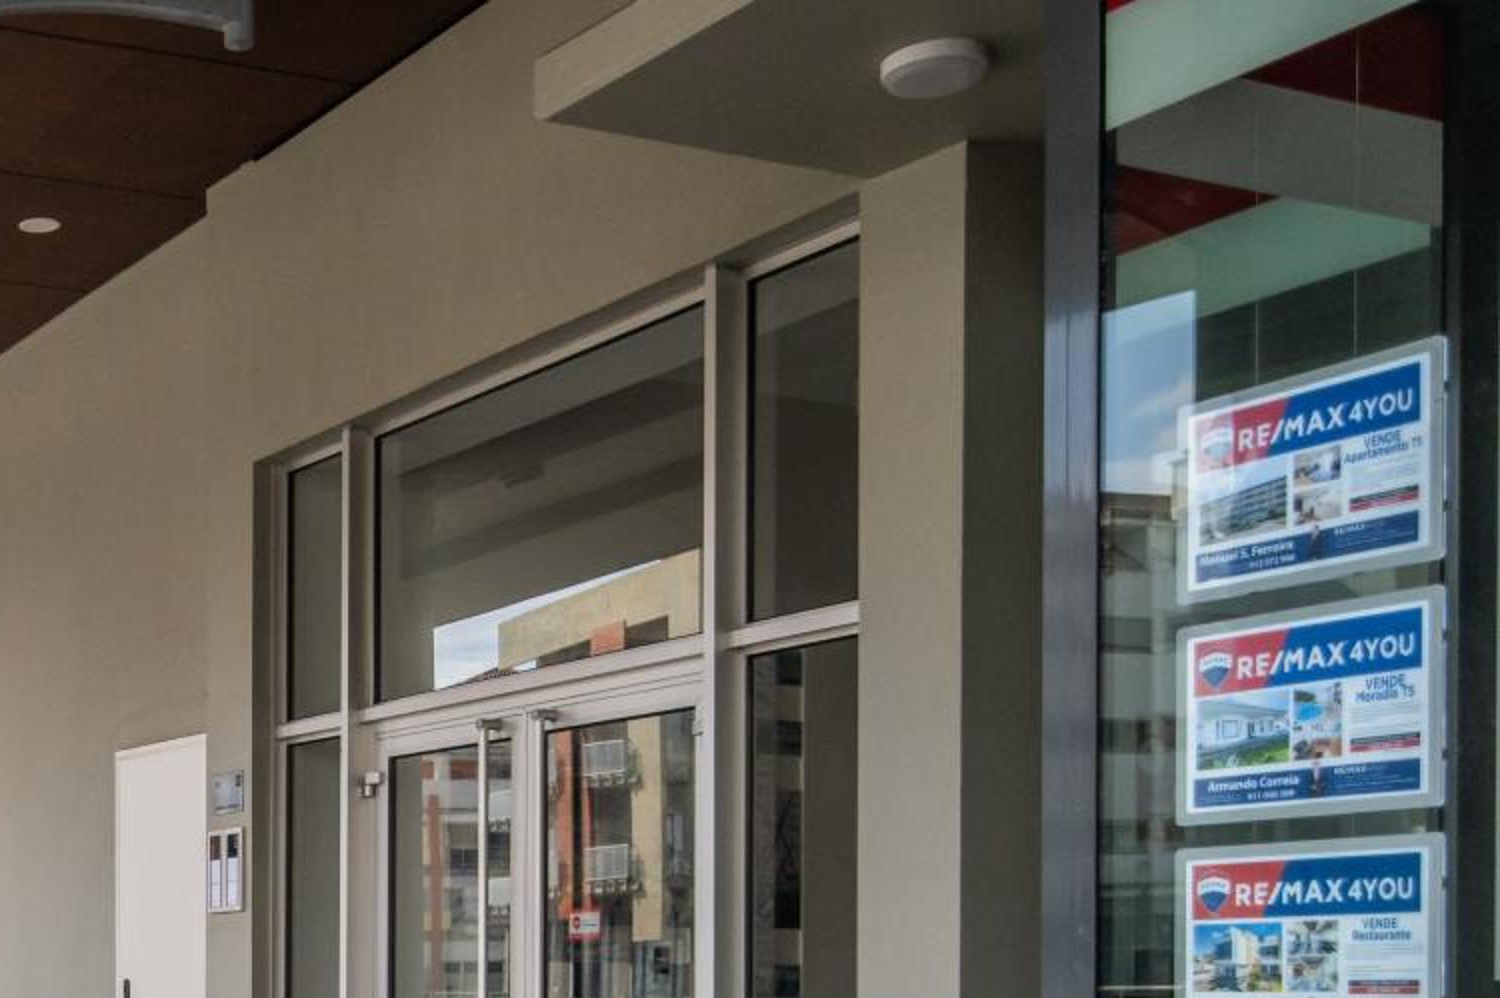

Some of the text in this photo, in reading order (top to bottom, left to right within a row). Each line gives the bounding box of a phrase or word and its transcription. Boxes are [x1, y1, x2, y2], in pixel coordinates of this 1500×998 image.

[1237, 387, 1414, 452] RE/MAX 4YOU
[1363, 430, 1401, 448] VENDE
[1236, 640, 1345, 680] RE/MAX
[1349, 631, 1415, 664] 4YOU
[1365, 674, 1405, 690] VENDE
[1207, 774, 1300, 793] Armando Correia
[1235, 878, 1345, 908] RE/MAX
[1348, 876, 1414, 902] 4YOU
[1363, 917, 1398, 929] VENDE
[1351, 928, 1411, 941] Restaurante
